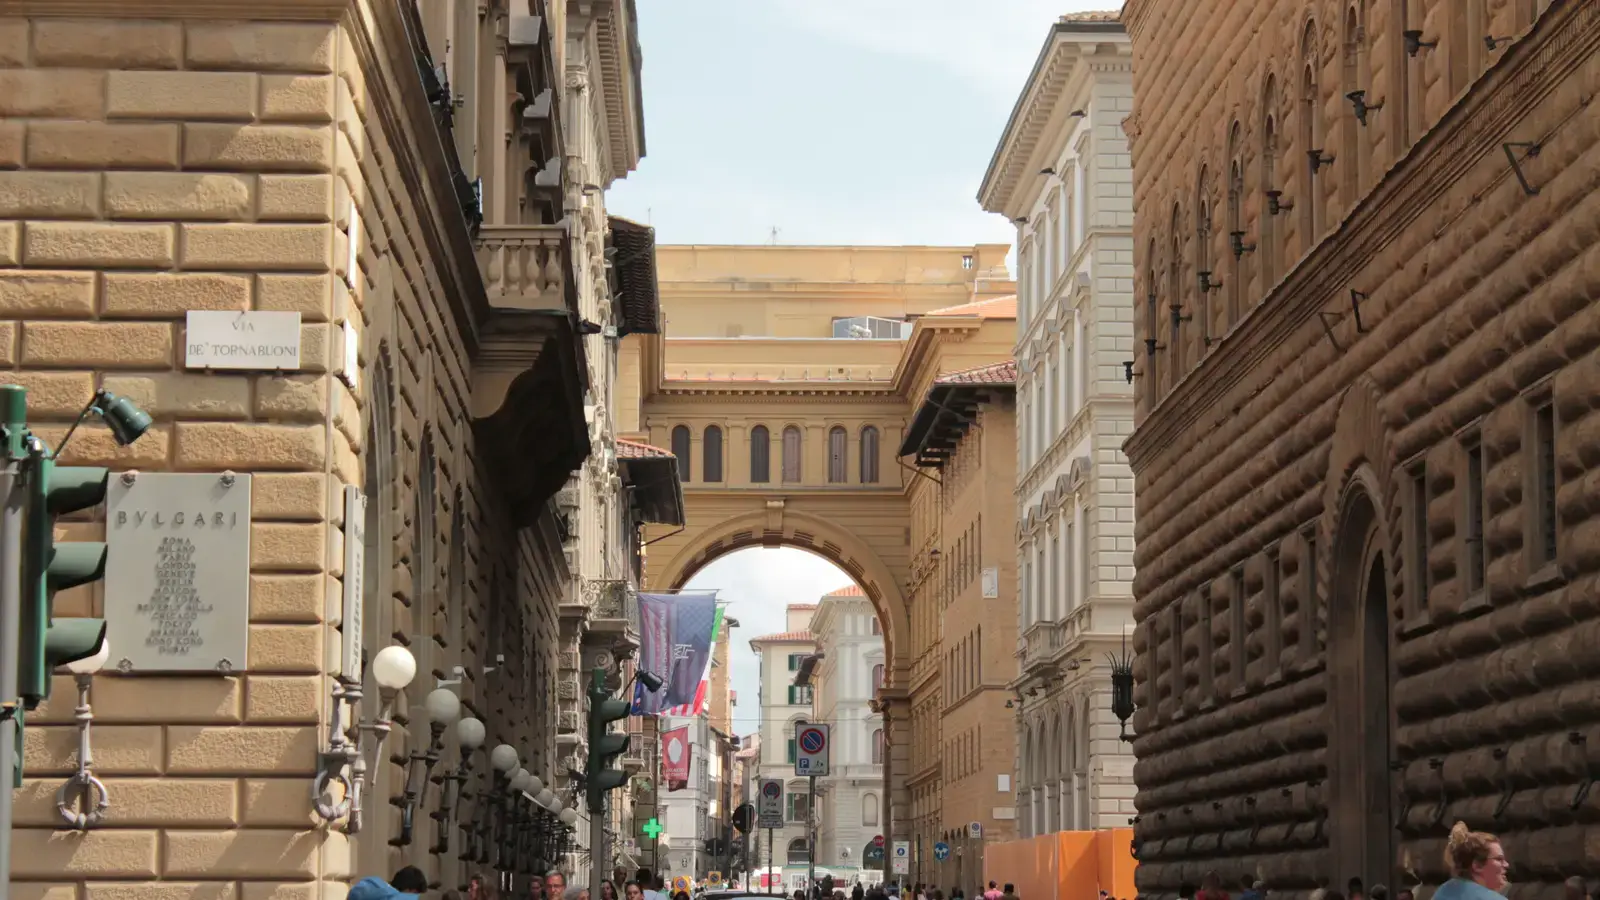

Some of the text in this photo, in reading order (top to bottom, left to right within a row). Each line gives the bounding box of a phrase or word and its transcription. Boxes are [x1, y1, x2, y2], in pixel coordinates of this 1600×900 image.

[232, 322, 254, 332] VIA
[212, 344, 297, 357] TORNABUONI
[117, 511, 238, 526] BVLGARI
[162, 537, 191, 546] ROMA
[157, 545, 196, 554] MILANO
[155, 561, 197, 571] LONDON
